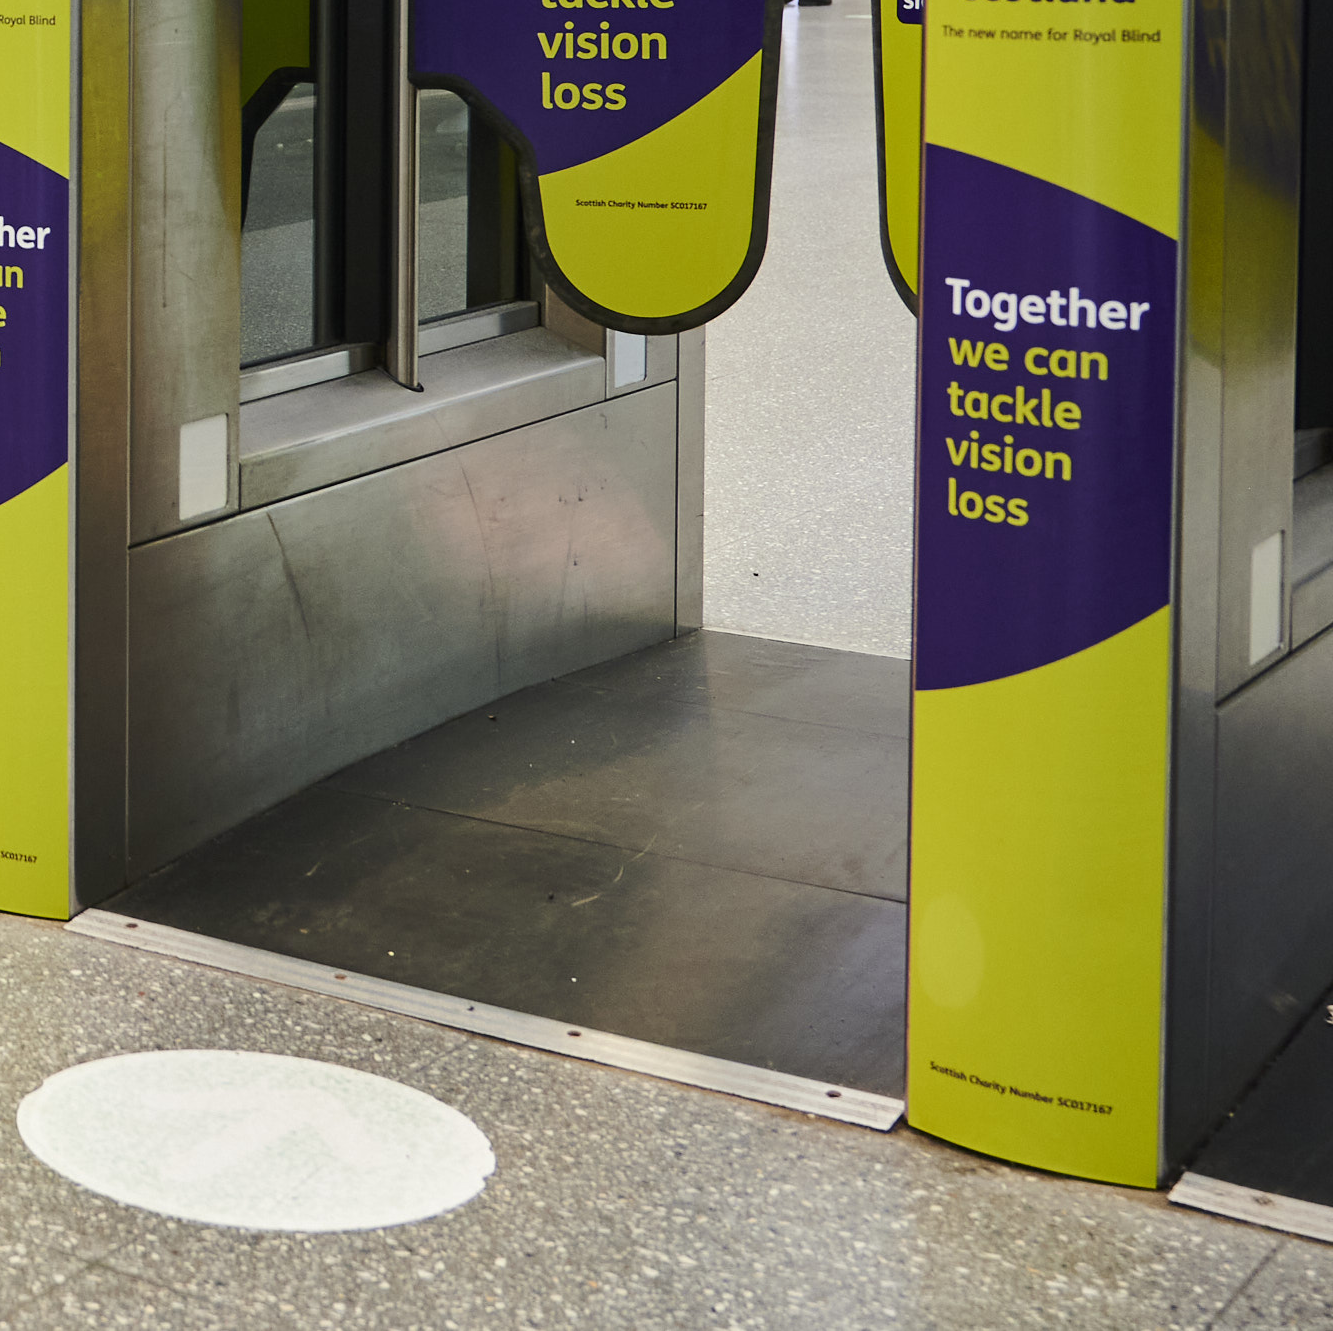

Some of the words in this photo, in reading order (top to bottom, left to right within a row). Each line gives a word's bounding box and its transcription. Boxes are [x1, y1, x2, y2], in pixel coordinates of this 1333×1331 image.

[29, 15, 56, 26] Blind
[537, 20, 668, 60] vision
[942, 25, 965, 38] The
[968, 28, 996, 39] new
[1000, 29, 1042, 41] name
[1047, 28, 1069, 41] for
[1073, 29, 1116, 45] Royal
[1121, 29, 1162, 43] Blind
[541, 71, 627, 111] loss
[575, 199, 606, 207] Scottish
[608, 200, 636, 209] Charity
[637, 201, 668, 209] Number
[945, 276, 1151, 332] Together
[948, 337, 1010, 371] we
[1024, 346, 1109, 381] can
[946, 381, 1082, 430] tackle
[945, 430, 1072, 481] vision
[948, 477, 1029, 527] loss
[930, 1060, 968, 1082] Scottish
[969, 1074, 1007, 1095] Charity
[1009, 1085, 1055, 1104] Number
[1057, 1096, 1113, 1116] SC017167
